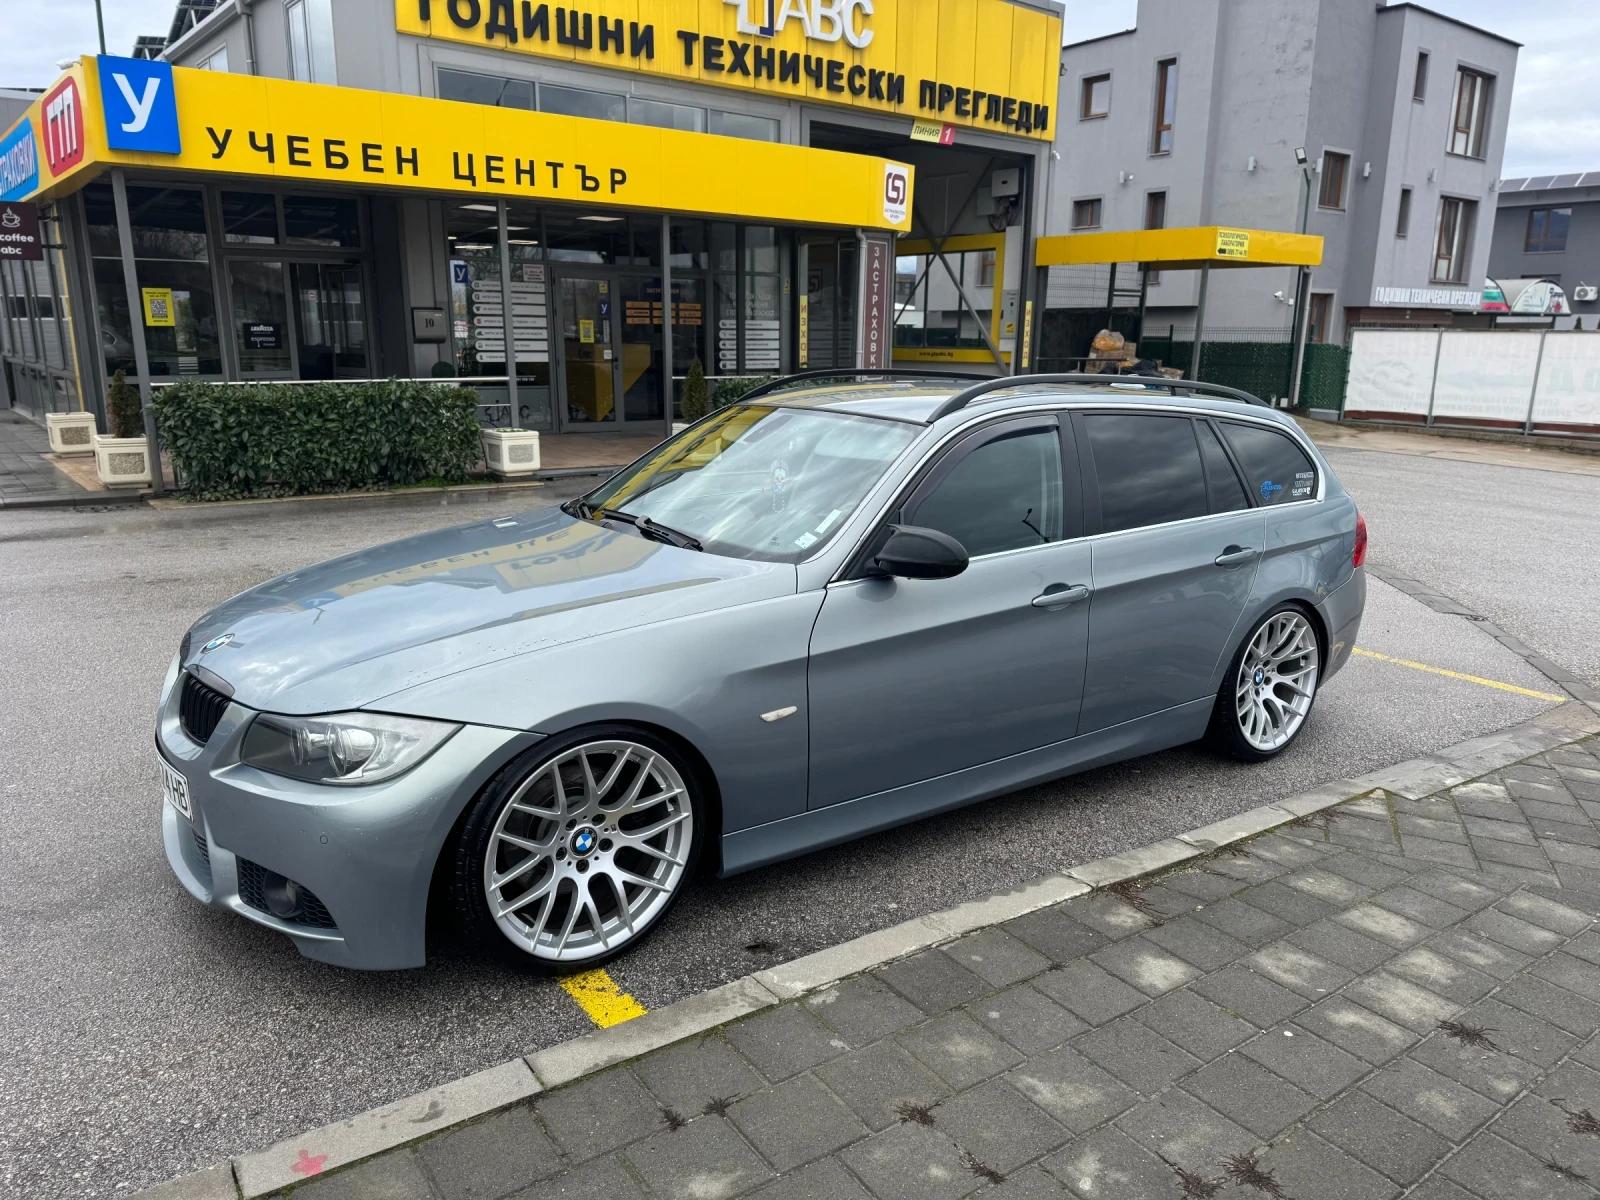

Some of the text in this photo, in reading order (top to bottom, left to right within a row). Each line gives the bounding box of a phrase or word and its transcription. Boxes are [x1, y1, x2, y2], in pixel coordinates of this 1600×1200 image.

[677, 30, 905, 104] ТЕХНИЧЕСКИ
[919, 79, 1049, 133] ПРЕГЛЕДИ
[914, 125, 952, 142] ЛИНИЯ 1
[205, 126, 628, 194] УЧЕБЕН ЦЕНТЪР
[0, 233, 35, 243] coffee
[1, 246, 22, 254] abc
[1375, 287, 1482, 307] ГОДИШНИ ТЕХНИЧЕСКИ ПРЕГЛЕДИ
[424, 318, 435, 328] 10
[1023, 309, 1031, 359] ИЗХОД
